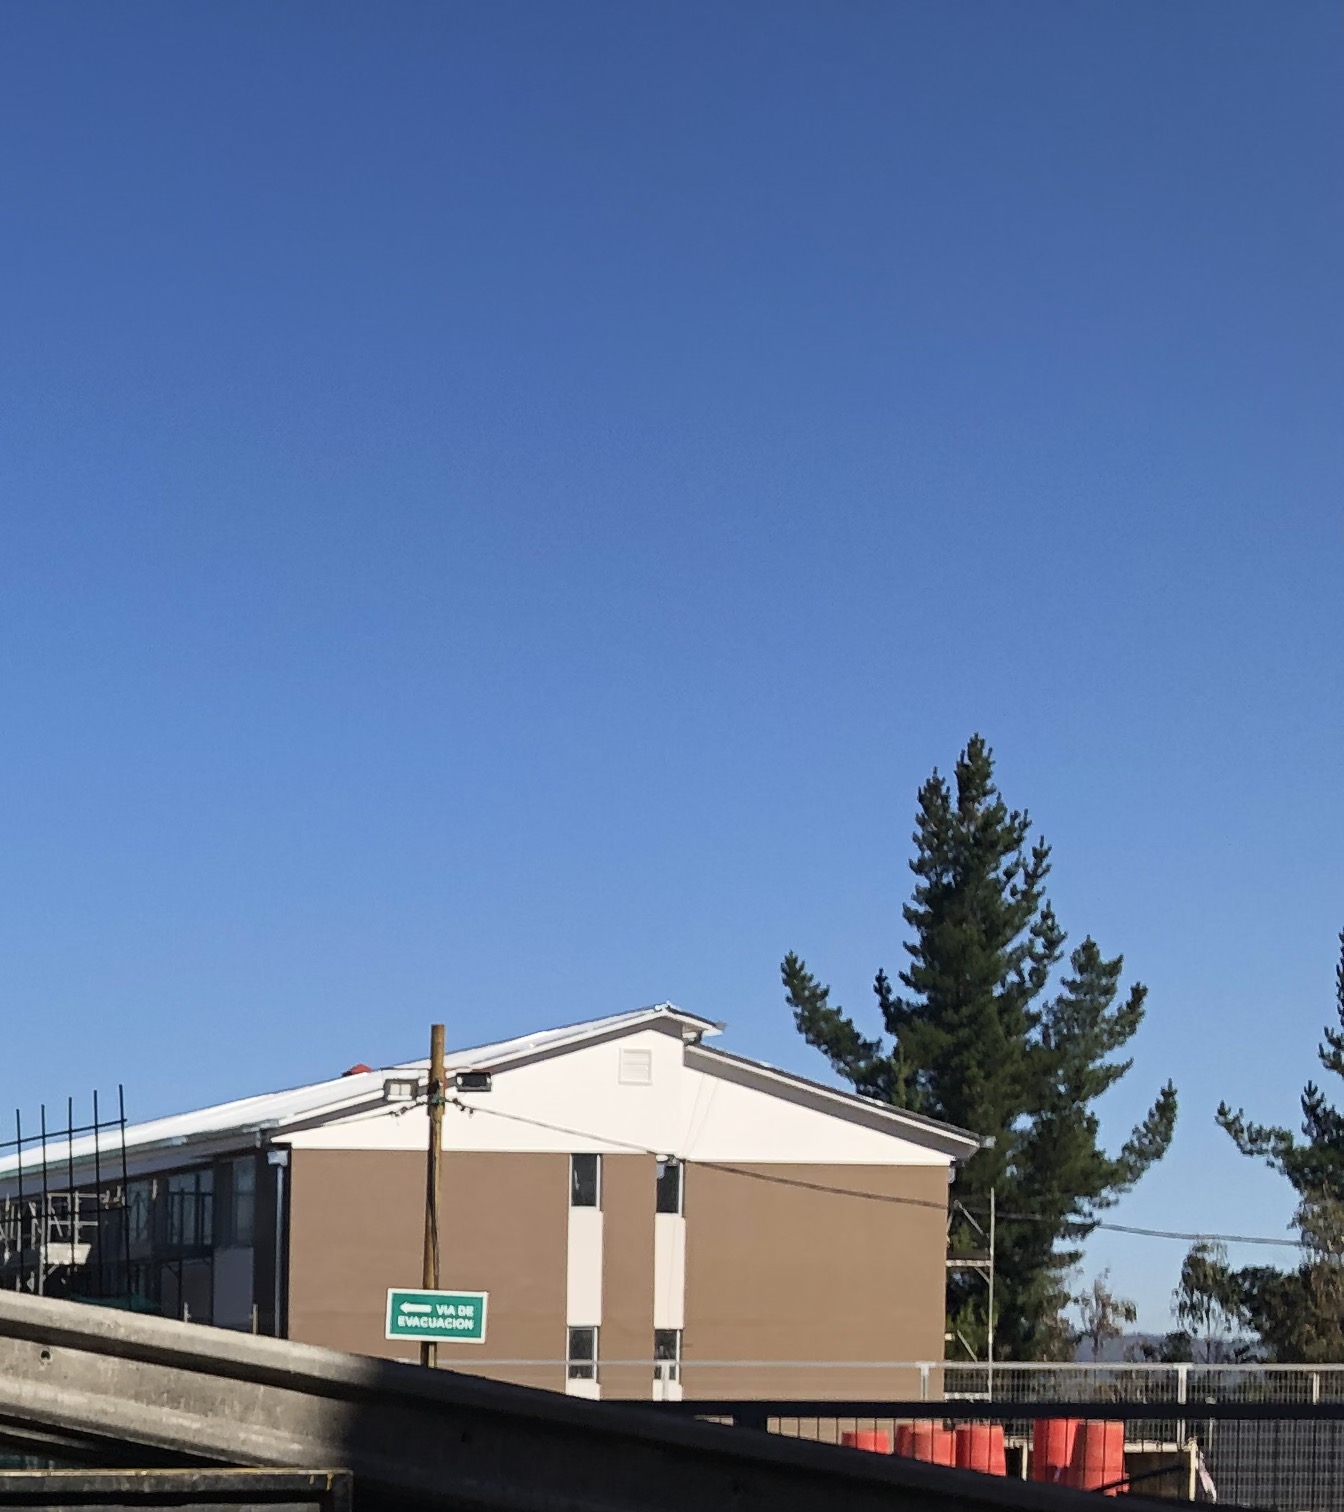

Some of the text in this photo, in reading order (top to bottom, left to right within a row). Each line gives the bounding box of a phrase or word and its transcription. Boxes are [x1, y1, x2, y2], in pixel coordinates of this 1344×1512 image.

[436, 1304, 474, 1317] VIA DE
[397, 1315, 474, 1330] EVACUACION
